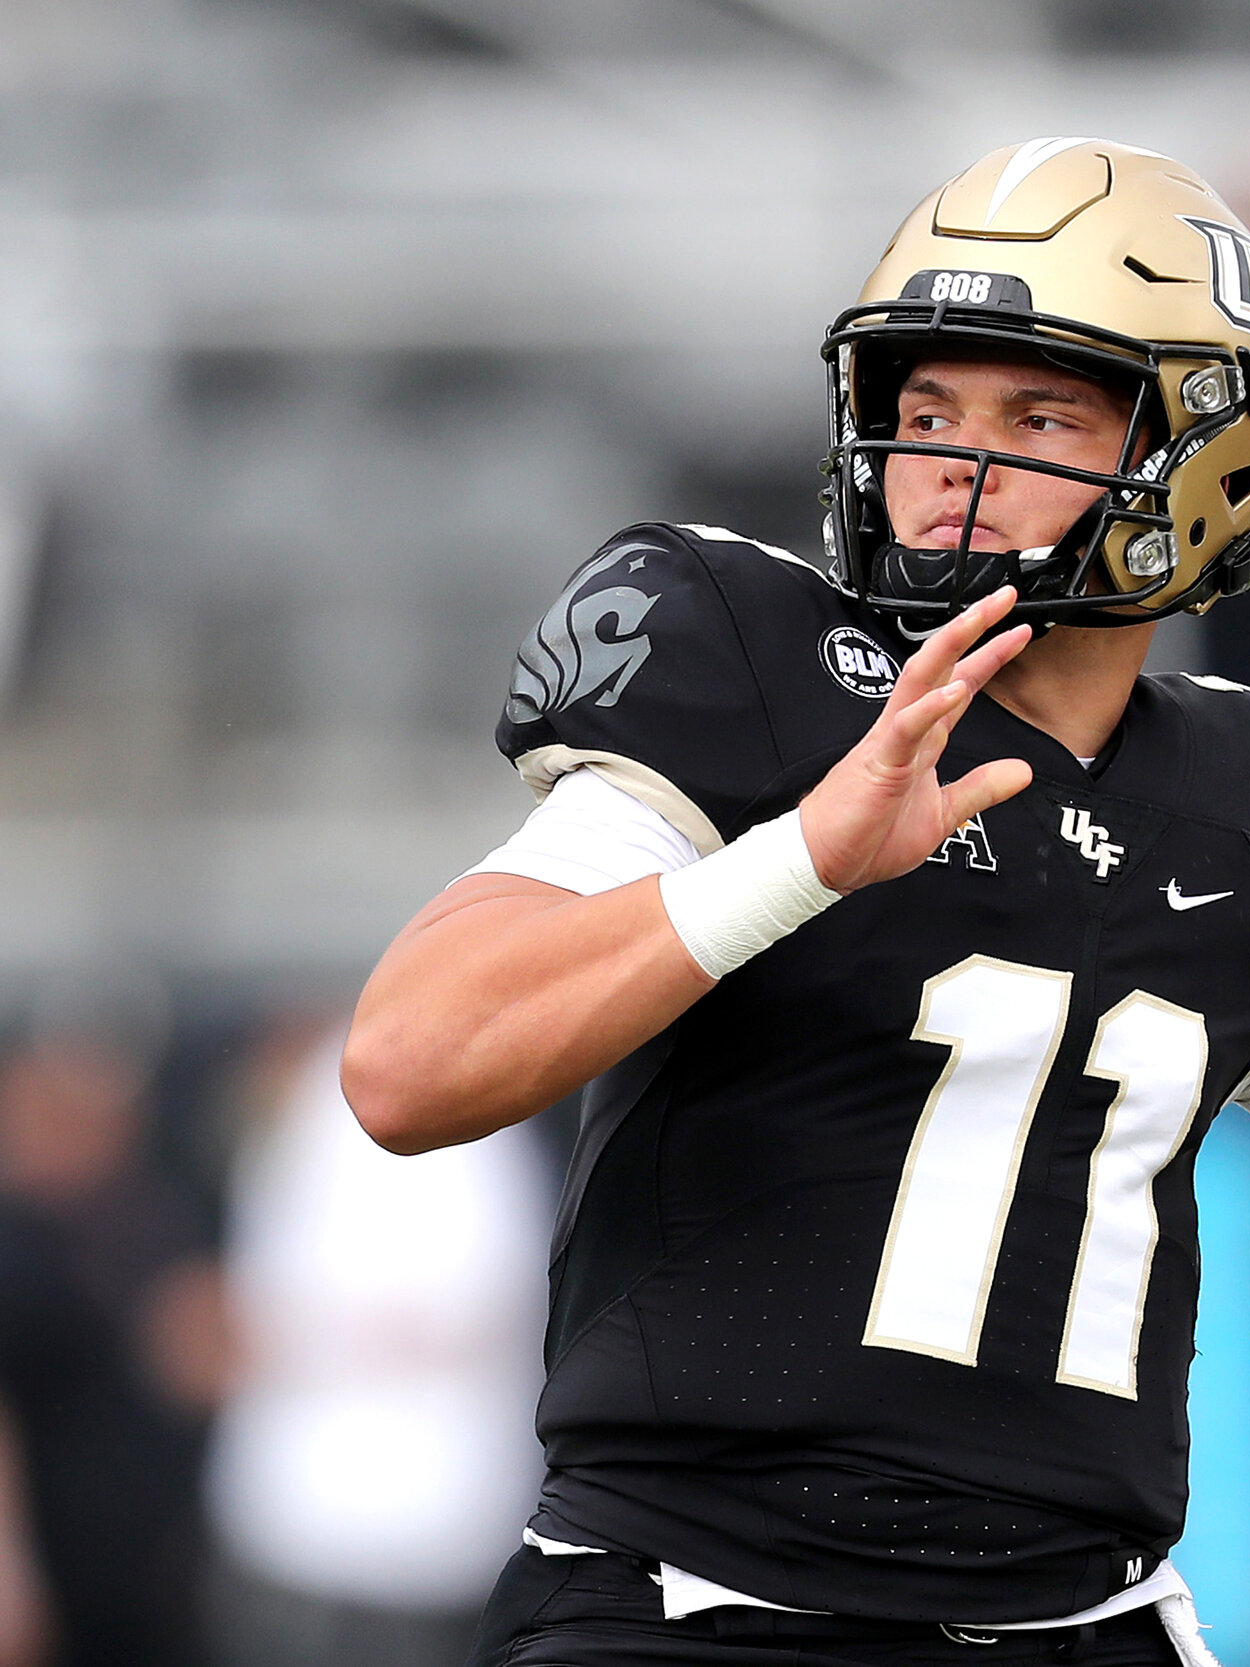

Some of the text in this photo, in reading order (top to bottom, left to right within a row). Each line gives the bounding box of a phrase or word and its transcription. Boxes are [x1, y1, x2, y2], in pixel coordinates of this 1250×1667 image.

[930, 272, 992, 304] 808
[834, 643, 895, 680] BLM
[1060, 806, 1125, 878] UCF
[861, 953, 1209, 1401] 11
[1125, 1556, 1142, 1585] M
